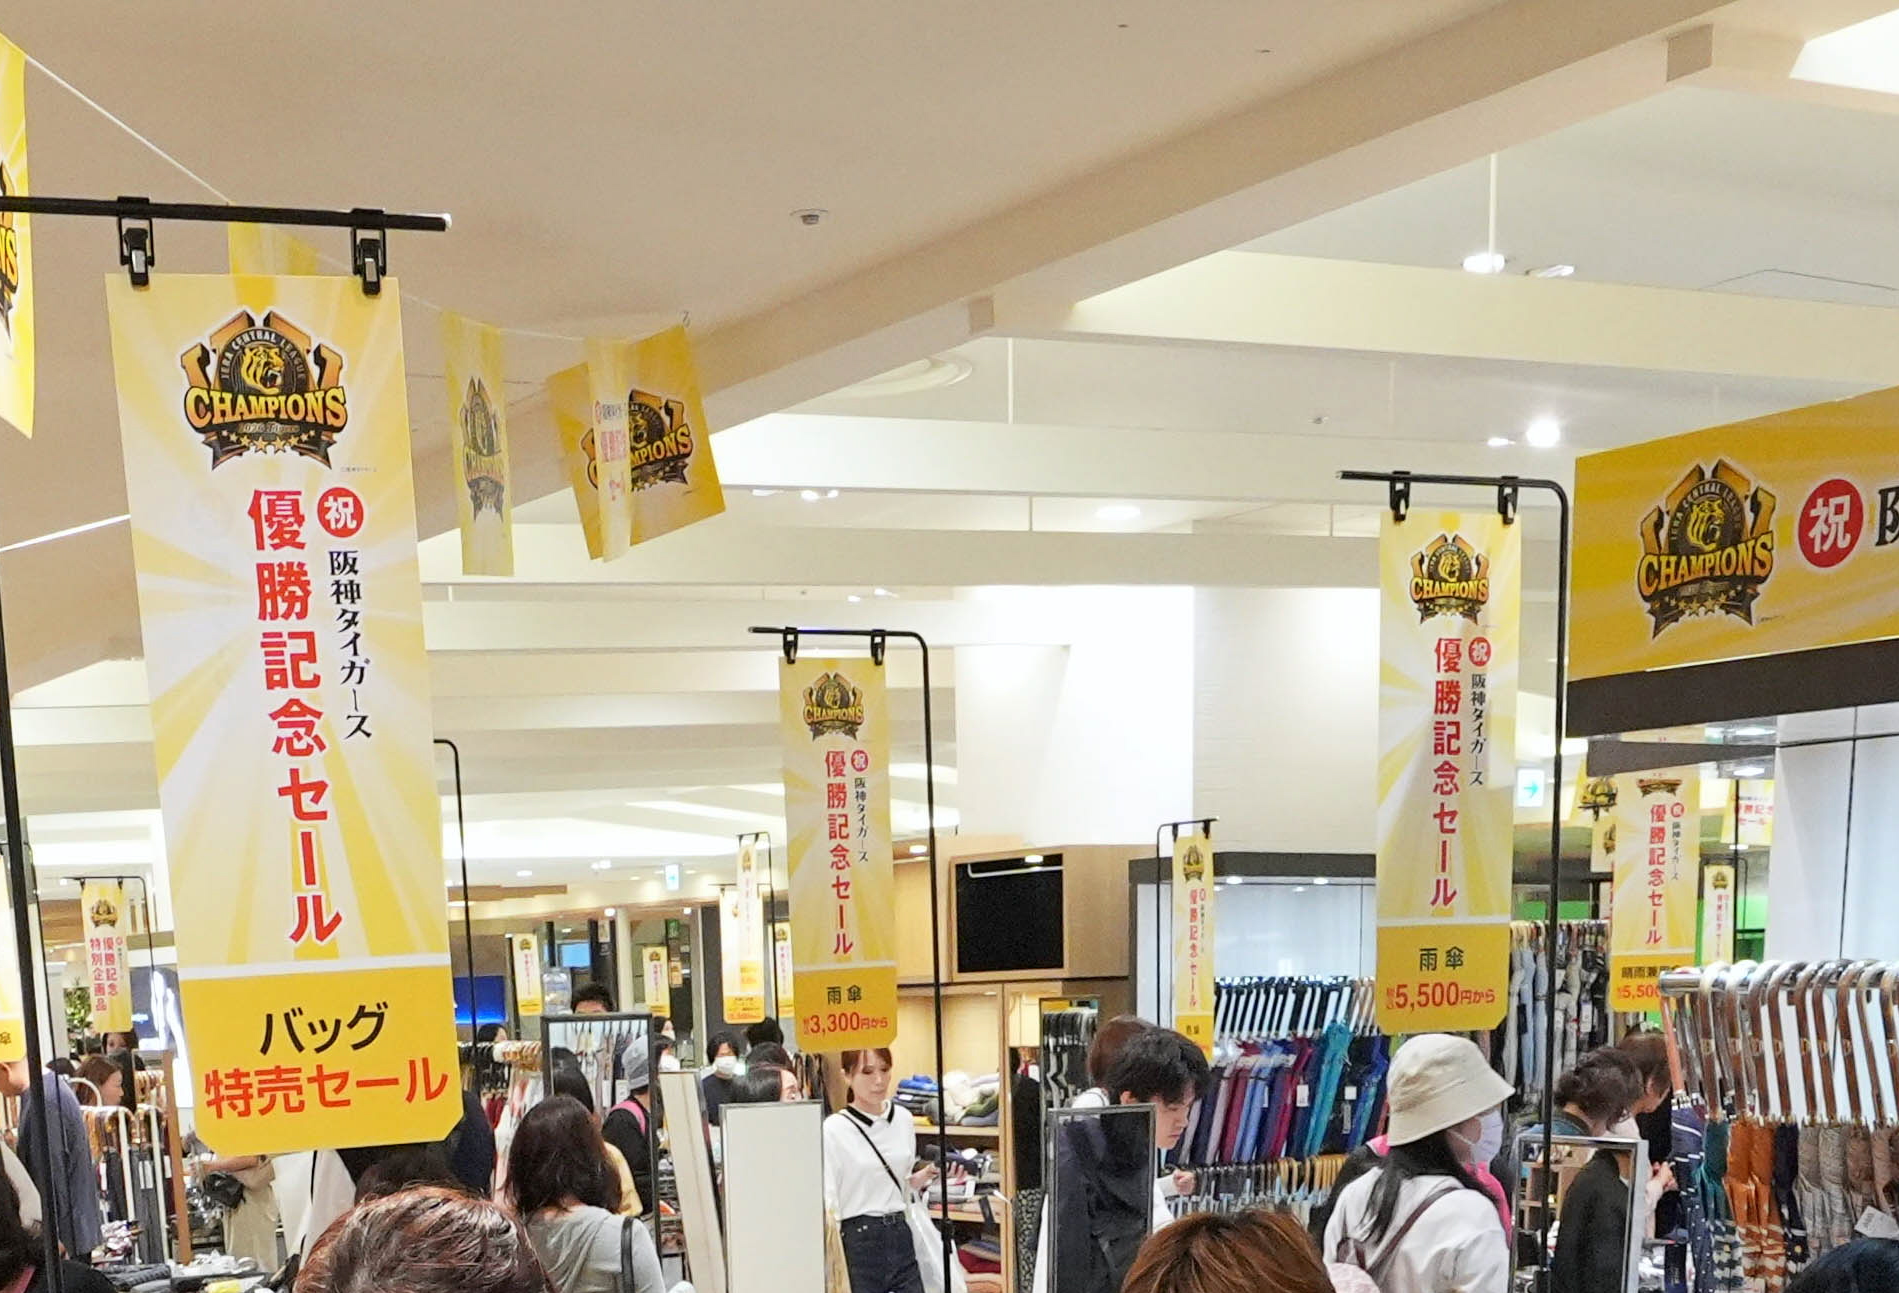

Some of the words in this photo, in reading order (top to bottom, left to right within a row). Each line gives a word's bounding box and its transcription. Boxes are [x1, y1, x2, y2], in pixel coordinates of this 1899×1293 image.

[184, 386, 348, 432] CHAMPIONS
[320, 490, 361, 534] 祝
[1804, 488, 1858, 558] 祝
[1410, 577, 1490, 603] CHAMPIONS
[1638, 531, 1774, 597] CHAMPIONS
[327, 550, 372, 740] 阪神タイガース
[247, 488, 343, 945] 優勝記念セール
[803, 704, 865, 724] CHAMPIONS
[1469, 672, 1487, 788] 阪神タイガース
[1429, 637, 1462, 909] 優勝記念セール
[824, 749, 854, 957] 優勝記念セール
[1645, 804, 1667, 945] 優勝記念セール
[1419, 946, 1464, 972] 雨傘
[258, 1000, 390, 1056] バッグ
[203, 1056, 450, 1120] 特売セール
